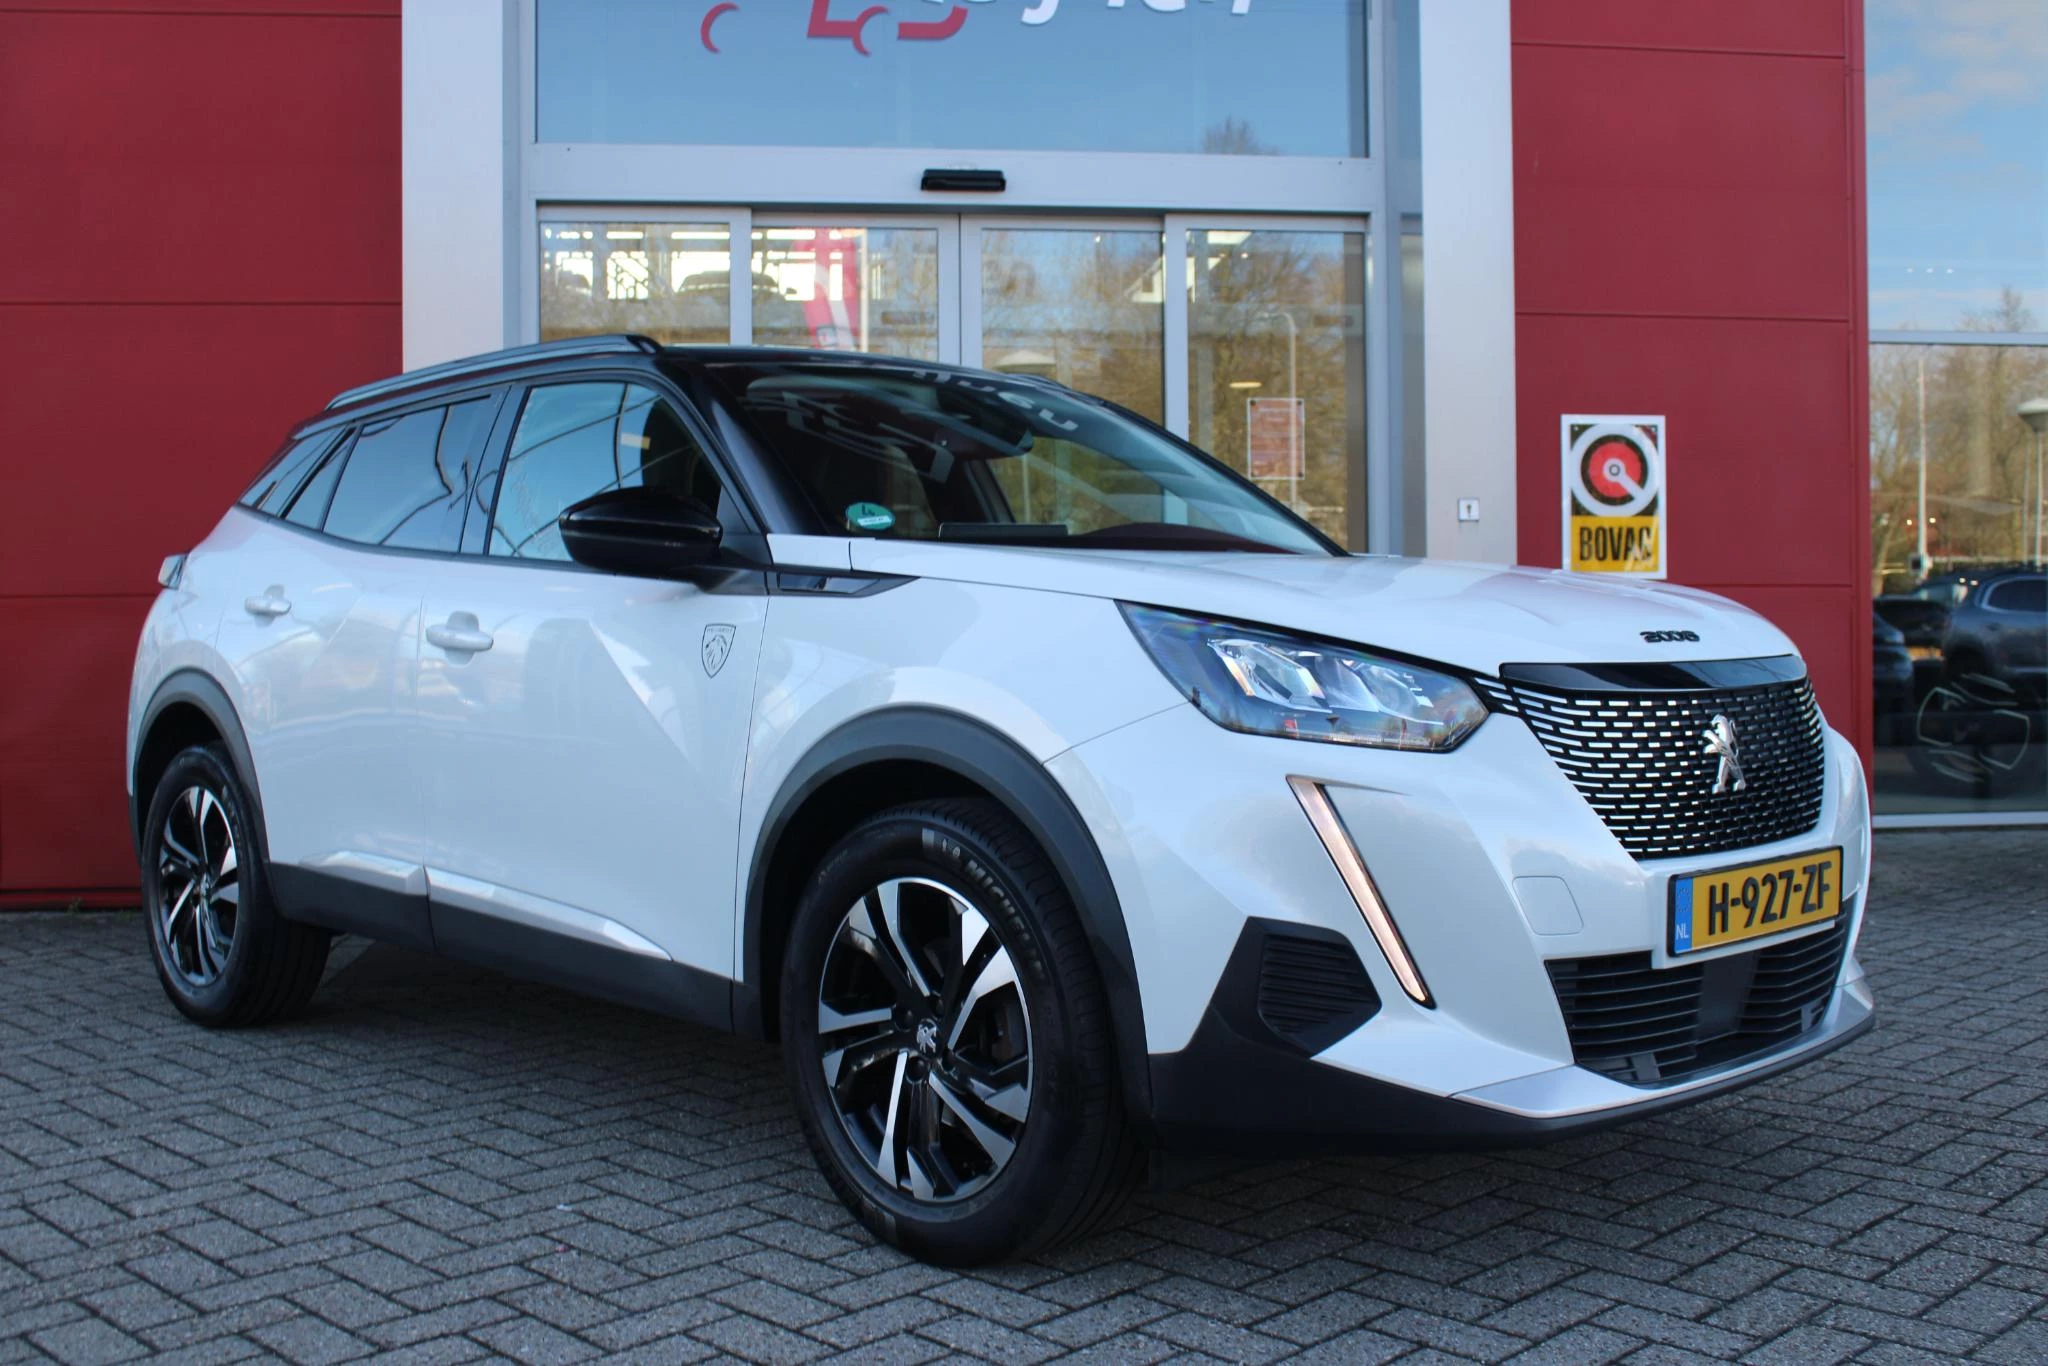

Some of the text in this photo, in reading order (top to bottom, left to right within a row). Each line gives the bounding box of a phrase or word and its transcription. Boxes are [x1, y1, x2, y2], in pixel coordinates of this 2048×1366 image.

[1640, 630, 1700, 643] 2008
[1708, 861, 1832, 936] H-927-ZF
[1676, 923, 1689, 940] NL
